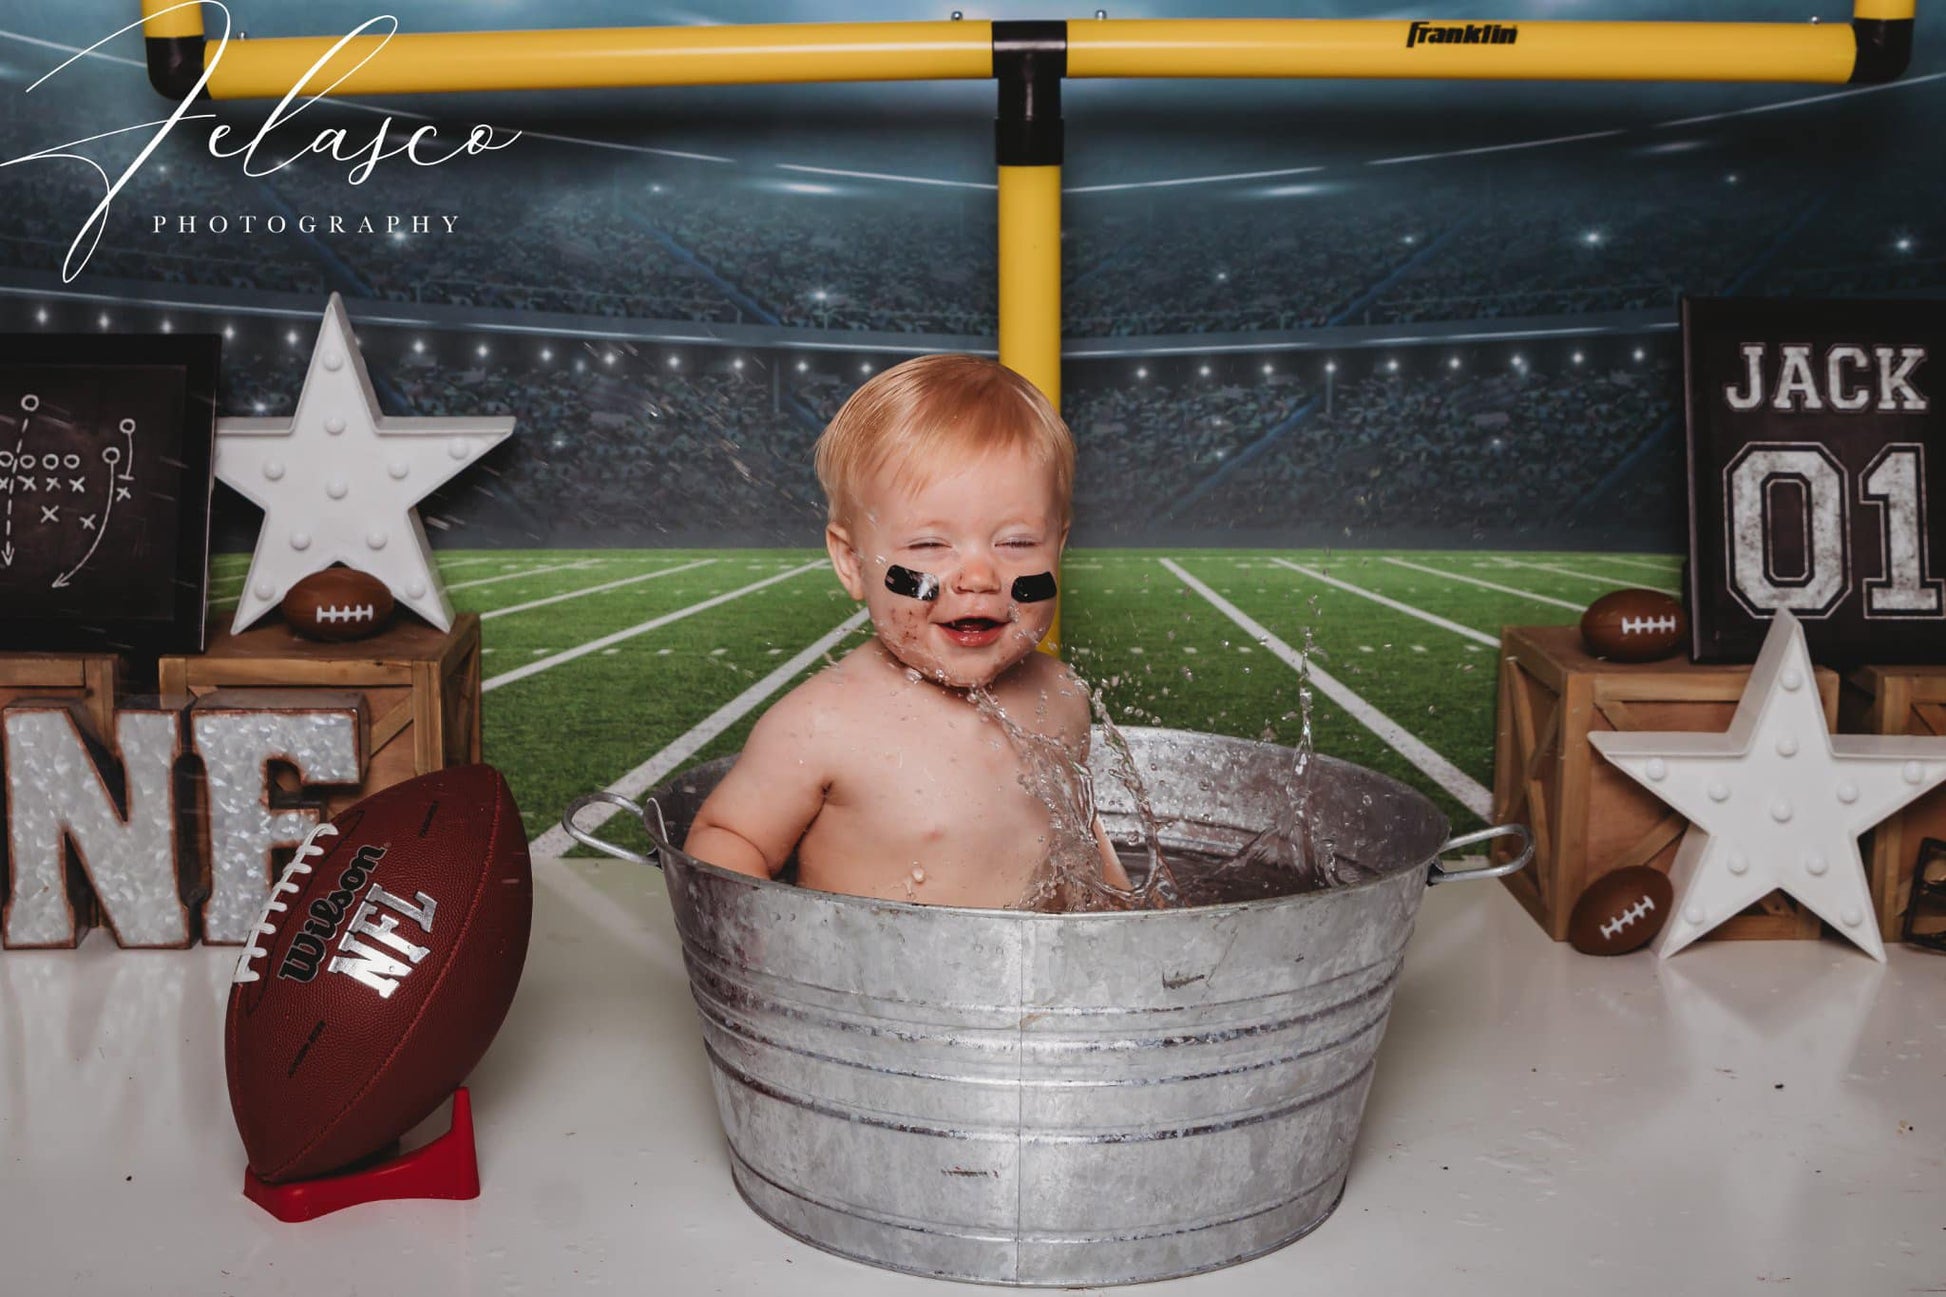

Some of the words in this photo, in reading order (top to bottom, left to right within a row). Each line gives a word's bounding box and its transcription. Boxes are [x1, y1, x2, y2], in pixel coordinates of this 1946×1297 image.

[1725, 342, 1929, 411] JACK
[1723, 441, 1946, 619] 01
[277, 844, 388, 983] Wilson
[327, 882, 438, 999] NFL
